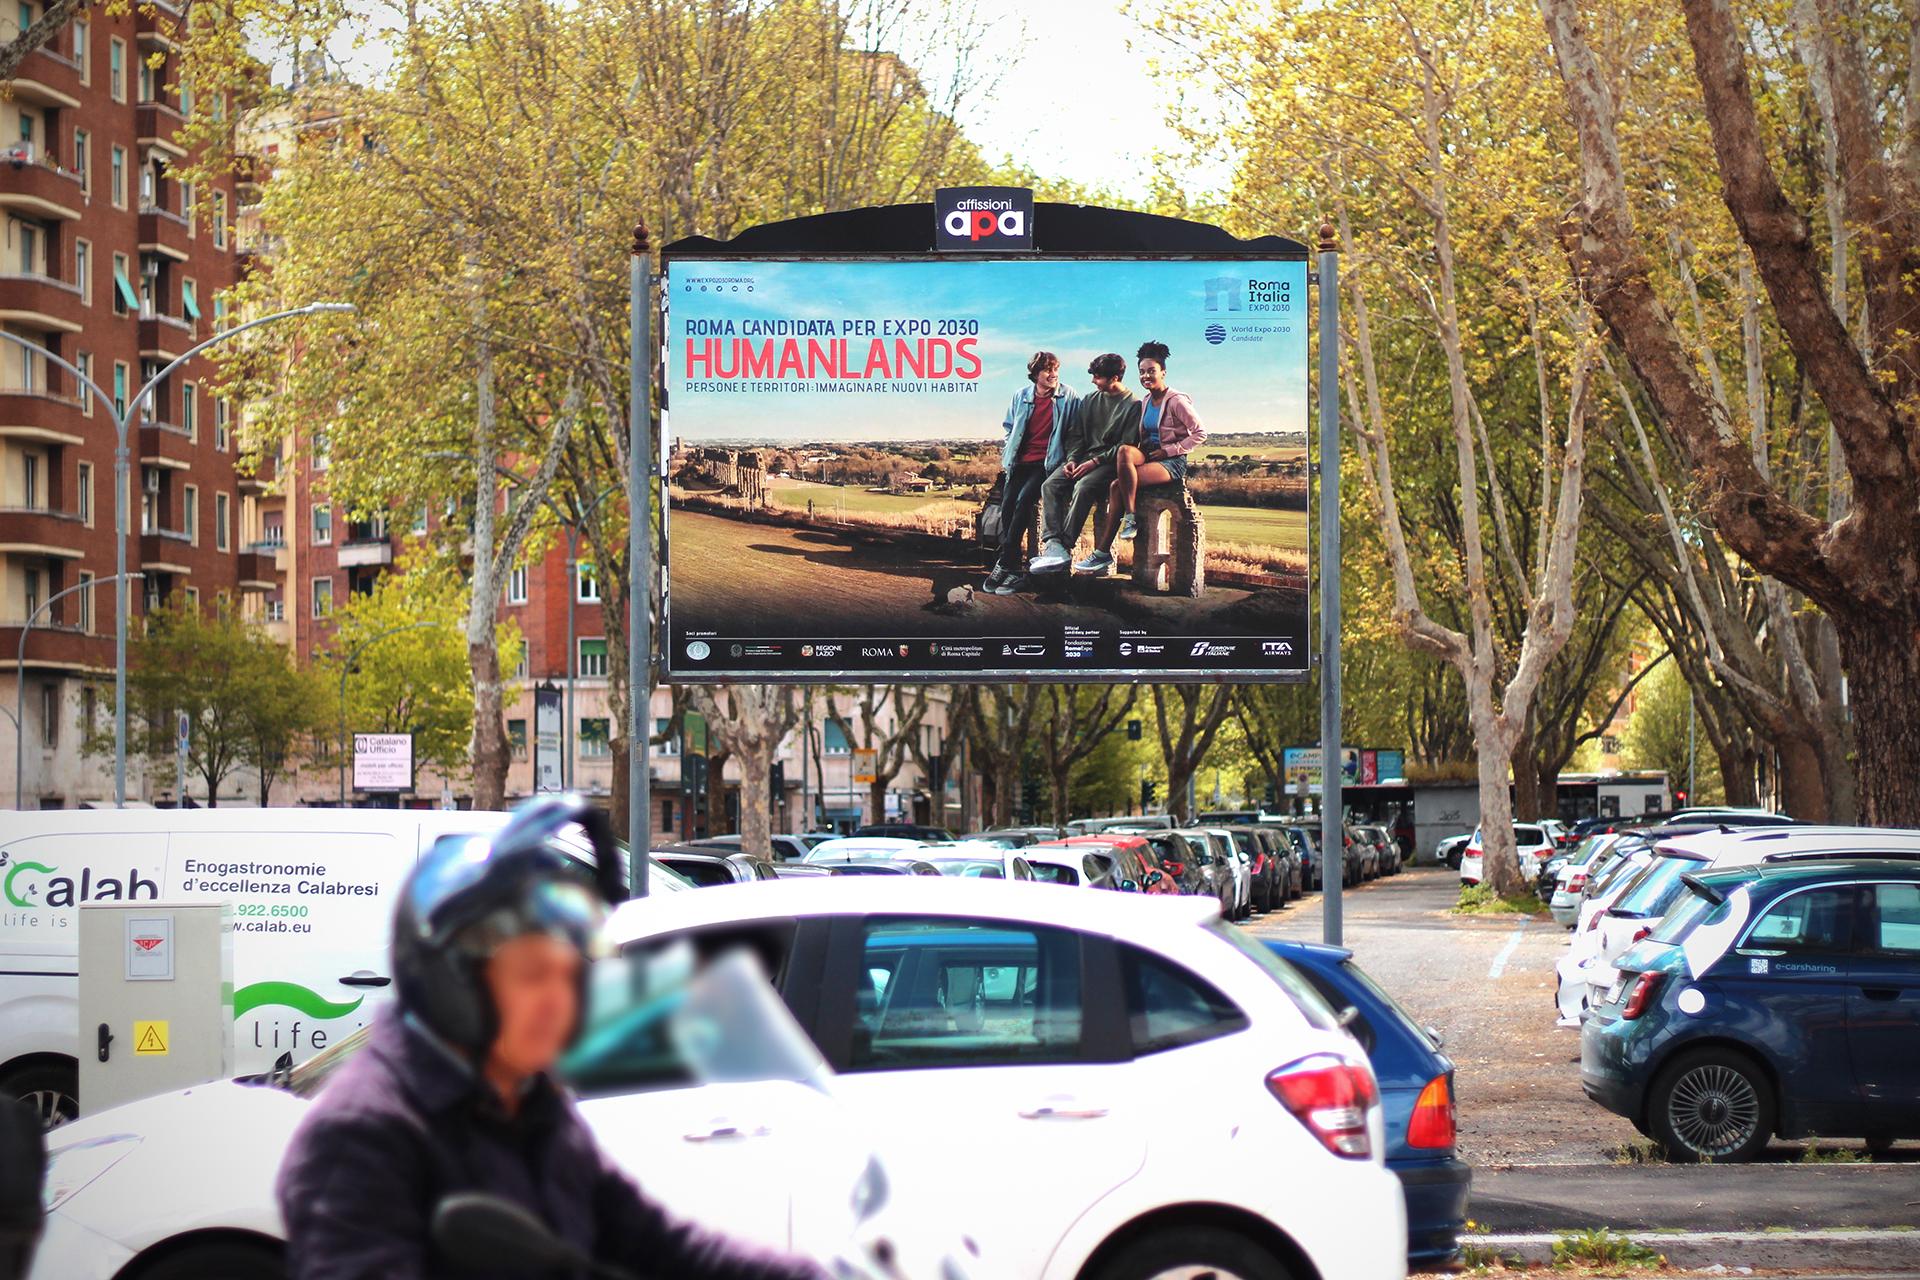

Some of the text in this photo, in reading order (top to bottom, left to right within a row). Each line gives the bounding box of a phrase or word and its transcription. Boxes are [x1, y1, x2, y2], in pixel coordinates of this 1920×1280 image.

[957, 199, 1012, 210] affissioni
[945, 210, 1024, 241] apa
[1248, 279, 1290, 291] Roma
[1248, 290, 1290, 302] Italia
[1248, 304, 1290, 312] EXPO 2030
[686, 319, 979, 336] ROMA CANDIDATA PER EXPO 2030
[1254, 326, 1272, 334] Expo
[686, 337, 982, 380] HUMANLANDS
[686, 382, 738, 393] PERSONE
[741, 382, 747, 393] E
[892, 382, 928, 393] NUOVI
[931, 382, 979, 393] HABITAT
[862, 647, 894, 657] ROMA
[1262, 642, 1293, 650] ITA
[369, 736, 407, 746] Catalano
[369, 746, 397, 754] Ufficio
[185, 859, 327, 878] Enogastronomie
[4, 861, 159, 908] Calab
[183, 877, 379, 897] d'eccellenza Calabresi
[4, 913, 68, 928] life is
[232, 920, 312, 933] w.calab.eu
[1775, 963, 1836, 974] e-carsharing
[254, 1021, 327, 1050] life
